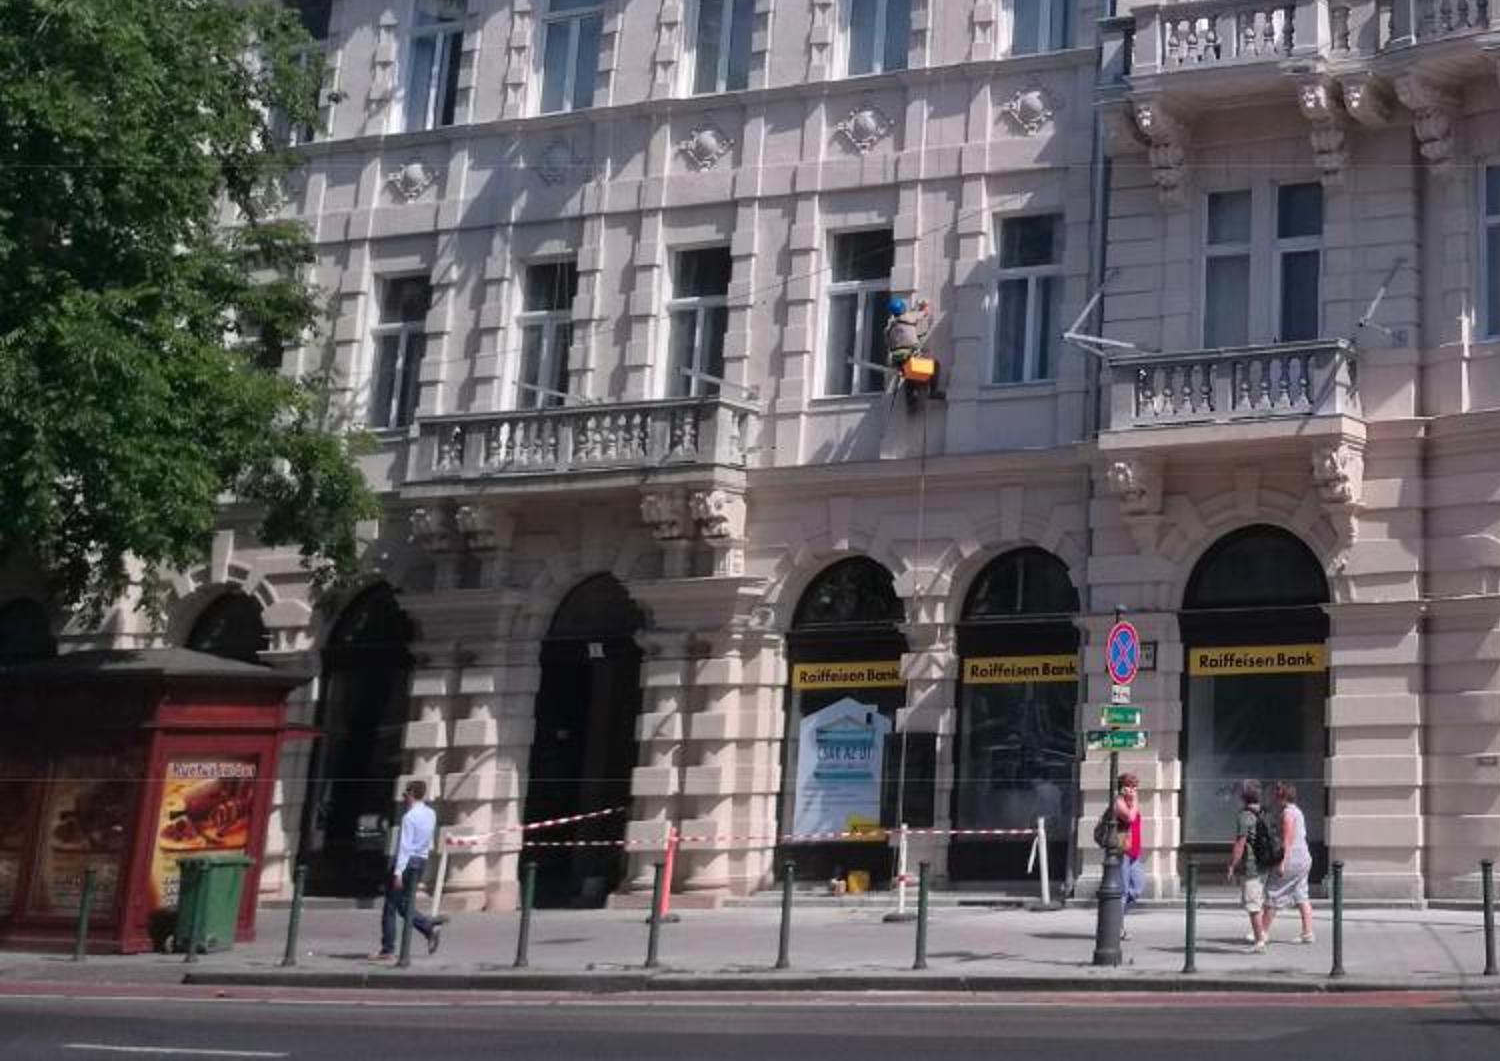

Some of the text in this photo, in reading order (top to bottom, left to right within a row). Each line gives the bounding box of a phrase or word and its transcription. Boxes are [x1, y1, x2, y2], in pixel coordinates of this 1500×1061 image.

[1199, 651, 1315, 668] Raiffeisen Bank
[799, 667, 899, 683] Raiffeisen Bank
[970, 660, 1078, 678] Raiffeisen Bank
